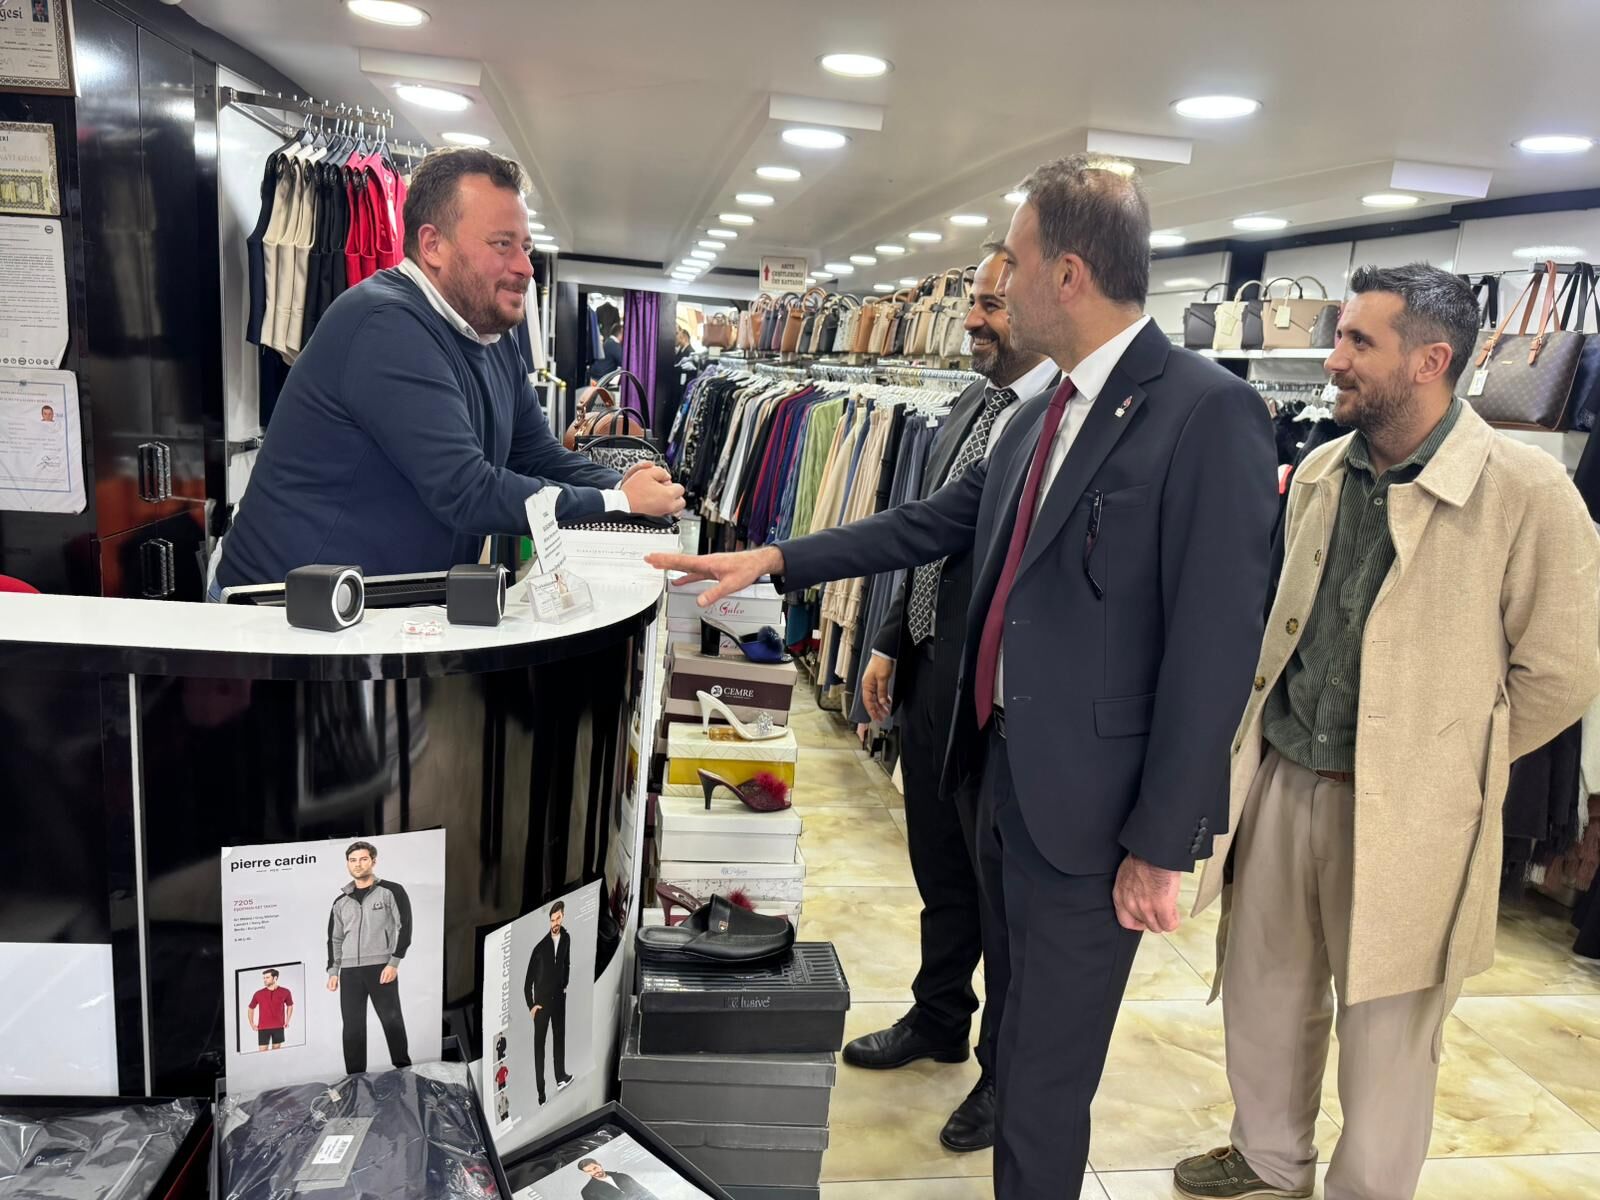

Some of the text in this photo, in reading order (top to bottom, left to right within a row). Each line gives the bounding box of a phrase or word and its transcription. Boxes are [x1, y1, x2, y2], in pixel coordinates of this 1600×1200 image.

[723, 687, 754, 698] CEMRE
[231, 858, 271, 872] pierre
[274, 854, 317, 867] cardin
[499, 929, 511, 1027] pierre cardin
